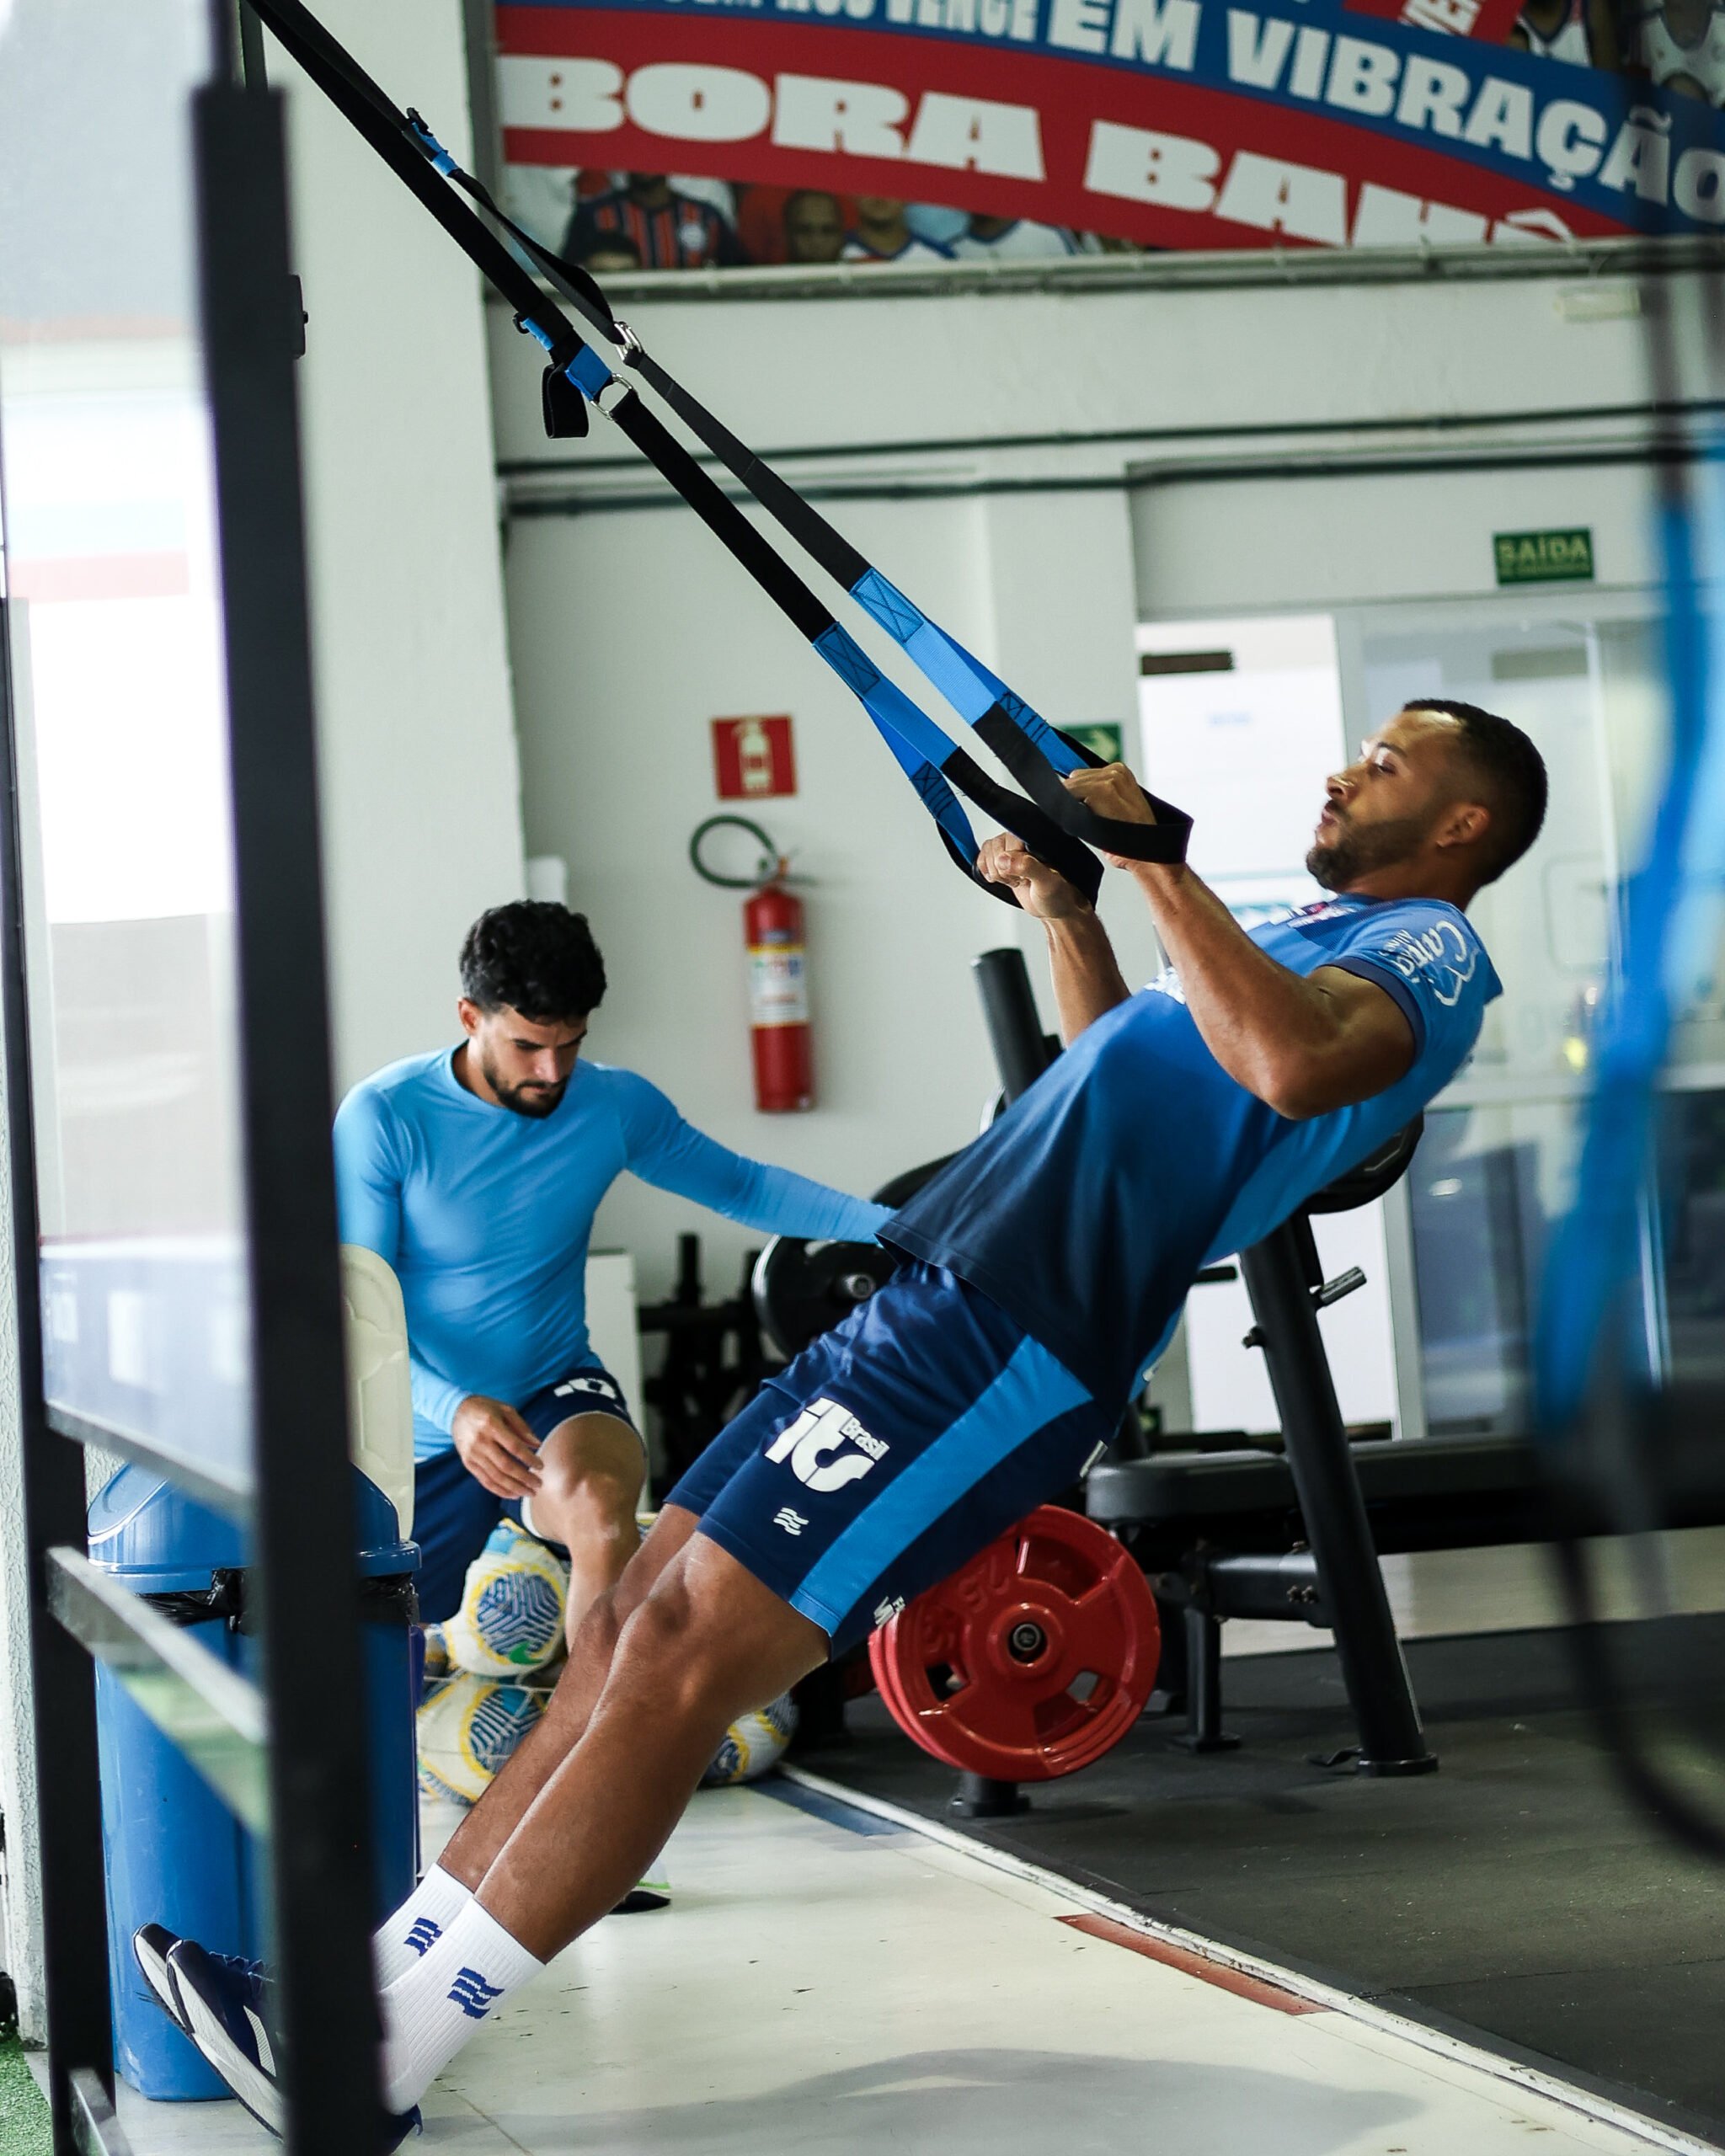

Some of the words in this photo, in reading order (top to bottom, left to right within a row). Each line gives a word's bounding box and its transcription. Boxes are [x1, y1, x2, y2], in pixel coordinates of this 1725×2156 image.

[495, 55, 1046, 182] BORA
[1084, 120, 1578, 248] BAH
[1049, 0, 1201, 72] EM
[1227, 10, 1725, 225] VIBRAÇÃO
[1498, 534, 1589, 563] SAÍDA
[839, 1417, 890, 1461] Brasil
